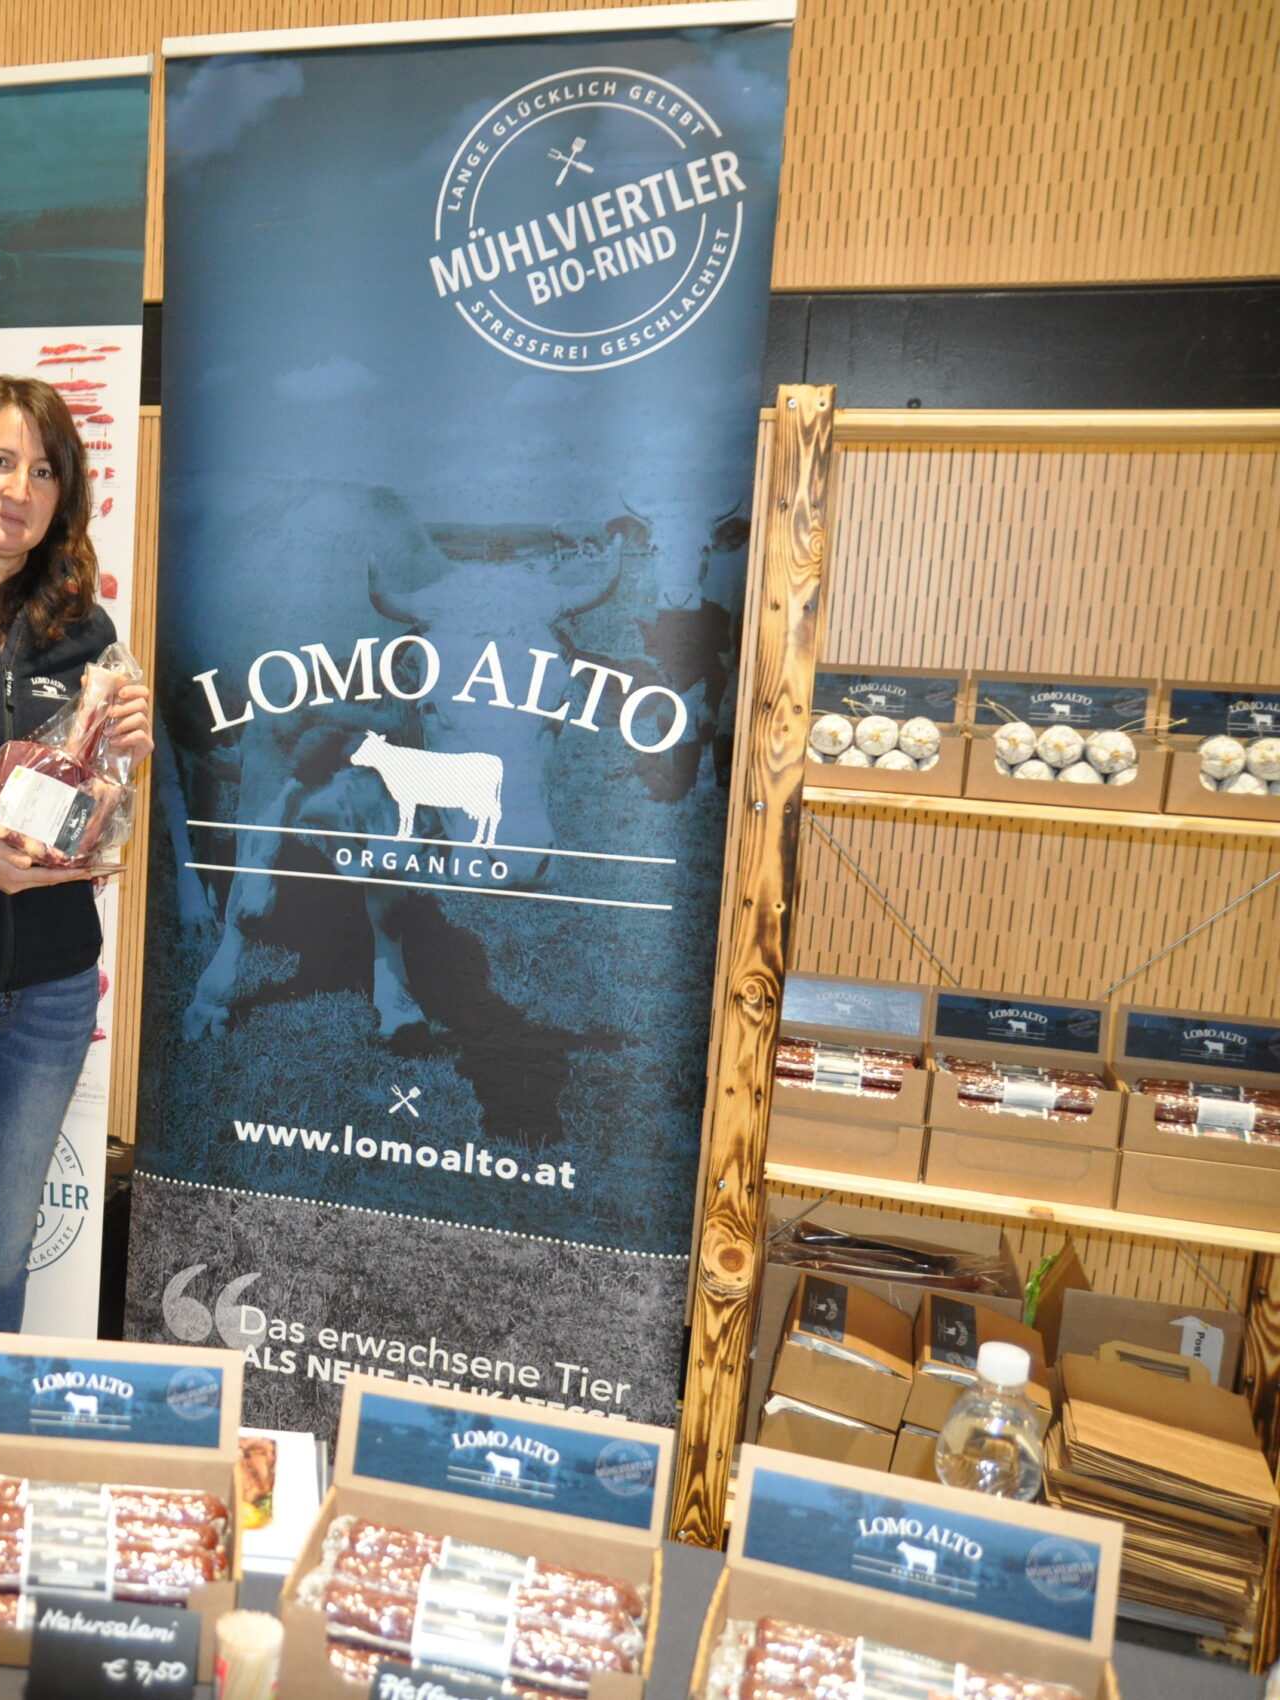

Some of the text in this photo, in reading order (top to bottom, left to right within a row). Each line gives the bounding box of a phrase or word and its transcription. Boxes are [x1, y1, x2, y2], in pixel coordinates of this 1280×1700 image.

[447, 81, 705, 212] LANGE GLÜCKLICH GELEBT
[429, 150, 747, 298] MÜHLVIERTLER
[526, 225, 677, 306] BIO-RIND
[471, 229, 730, 359] STRESSFREI GESCHLACHTET
[193, 635, 688, 753] LOMO ALTO
[848, 682, 907, 697] LOMO ALTO
[1030, 691, 1093, 706] LOMO ALTO
[1264, 702, 1280, 712] AL
[336, 847, 508, 879] ORGANICO
[989, 1008, 1048, 1024] LOMO ALTO
[1183, 1029, 1247, 1045] LOMO ALTO
[233, 1120, 575, 1189] www.lomoalto.at
[240, 1305, 305, 1343] Das
[319, 1325, 540, 1387] erwachsene
[555, 1361, 631, 1403] Tier
[241, 1344, 296, 1374] ALS
[1193, 1331, 1205, 1357] Post
[32, 1371, 134, 1399] LOMO ALTO
[452, 1430, 560, 1466] LOMO ALTO
[858, 1516, 983, 1560] LOMO ALTO
[39, 1608, 179, 1643] Natursalami
[102, 1658, 187, 1687] € 7,50
